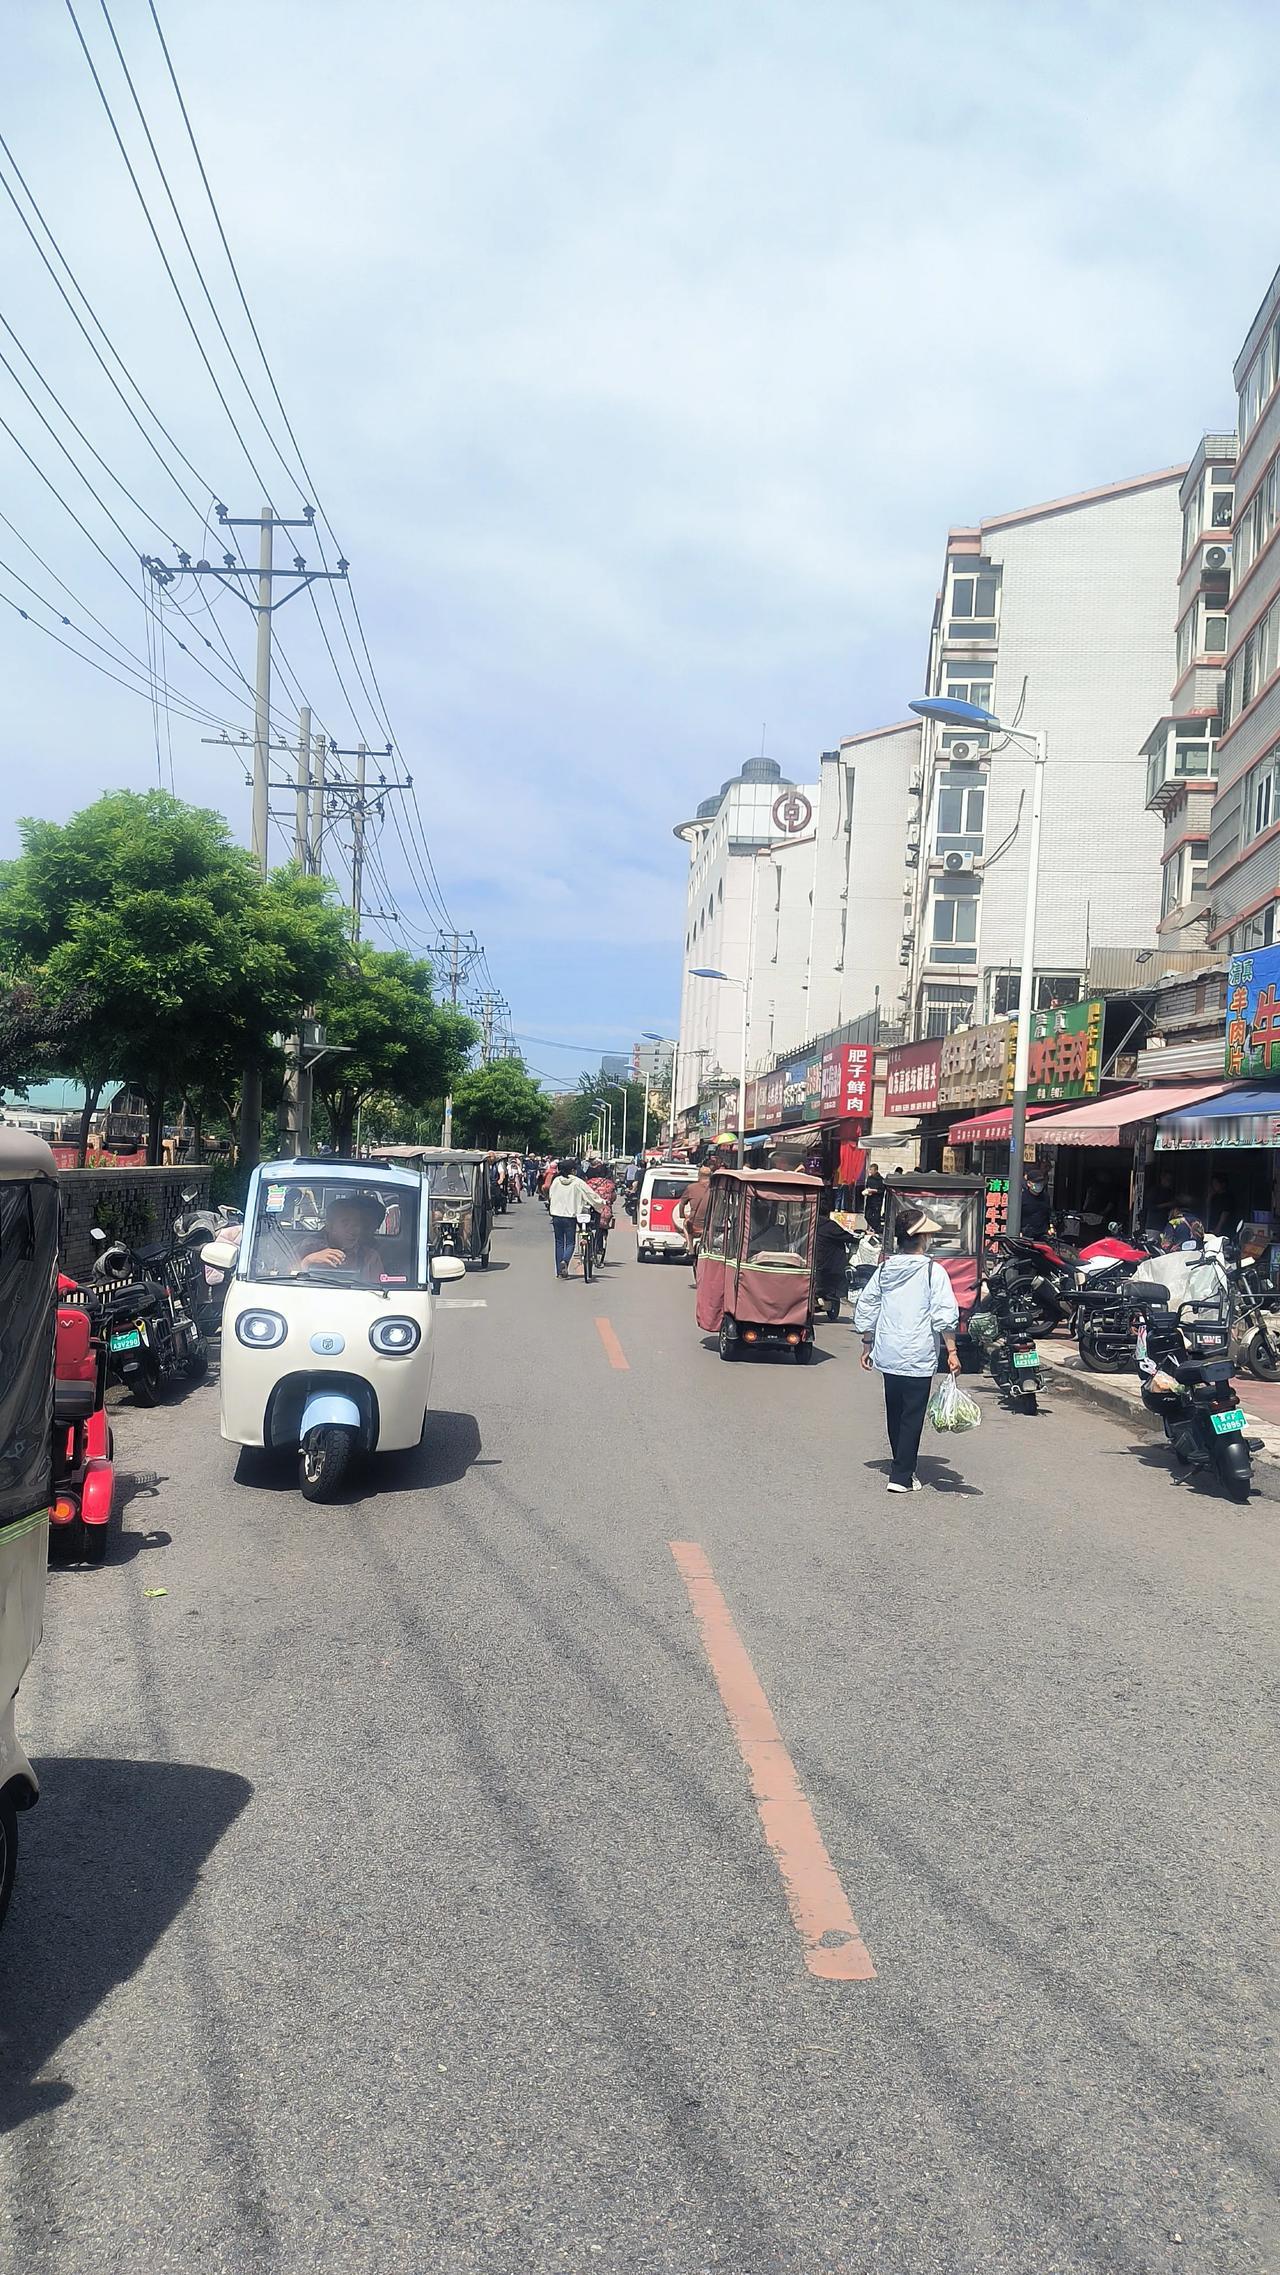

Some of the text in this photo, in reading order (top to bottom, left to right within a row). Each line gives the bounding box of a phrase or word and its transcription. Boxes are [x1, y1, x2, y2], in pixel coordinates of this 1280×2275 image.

[1229, 959, 1254, 986] 清真
[1034, 1010, 1067, 1038] 清真
[1228, 986, 1248, 1077] 羊肉片
[1251, 984, 1280, 1070] 牛
[846, 1049, 868, 1112] 肥子鲜肉
